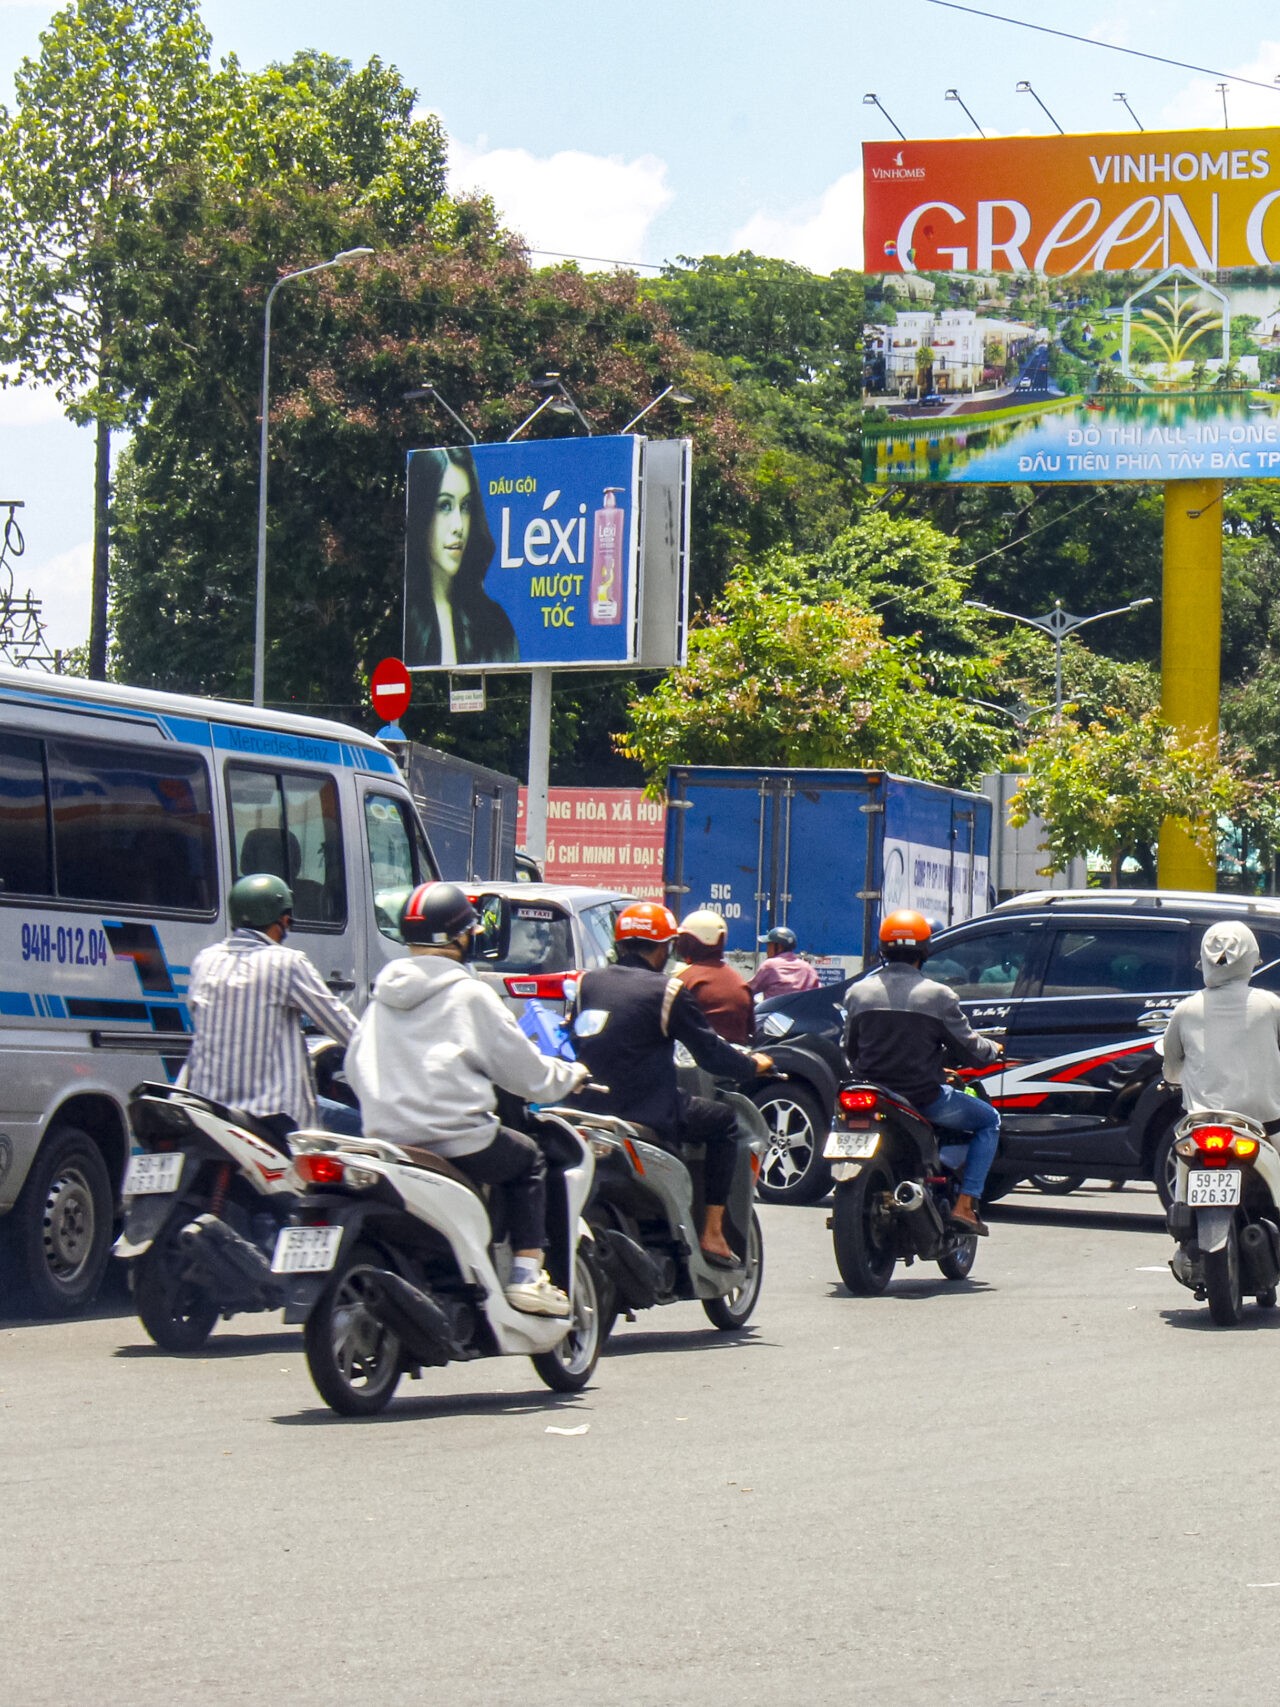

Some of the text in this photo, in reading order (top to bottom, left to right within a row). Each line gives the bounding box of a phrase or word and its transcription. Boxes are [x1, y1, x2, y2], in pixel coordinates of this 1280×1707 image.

[872, 167, 926, 179] VINHOMES
[1089, 149, 1270, 184] VINHOMES
[1067, 424, 1101, 447] ĐÔ
[1148, 424, 1278, 446] ALL-IN-ONE
[1017, 449, 1061, 472] ĐẦU
[1066, 450, 1110, 471] TIÊN
[1168, 449, 1205, 470] TÂY
[489, 475, 537, 497] DẤU GỘI
[501, 489, 587, 569] Léxi
[530, 572, 584, 602] MƯỢT
[541, 602, 575, 627] TÓC
[228, 728, 328, 760] Mercedes-Benz
[576, 798, 607, 821] HÒA
[611, 800, 633, 822] XÃ
[558, 843, 579, 864] CHÍ
[583, 847, 616, 865] MINH
[619, 844, 631, 865] VĨ
[633, 847, 654, 869] ĐẠI
[711, 884, 731, 899] 51C
[21, 923, 107, 967] 94H-012.04
[1196, 1173, 1233, 1187] 59-P2
[1191, 1188, 1236, 1203] 826.37
